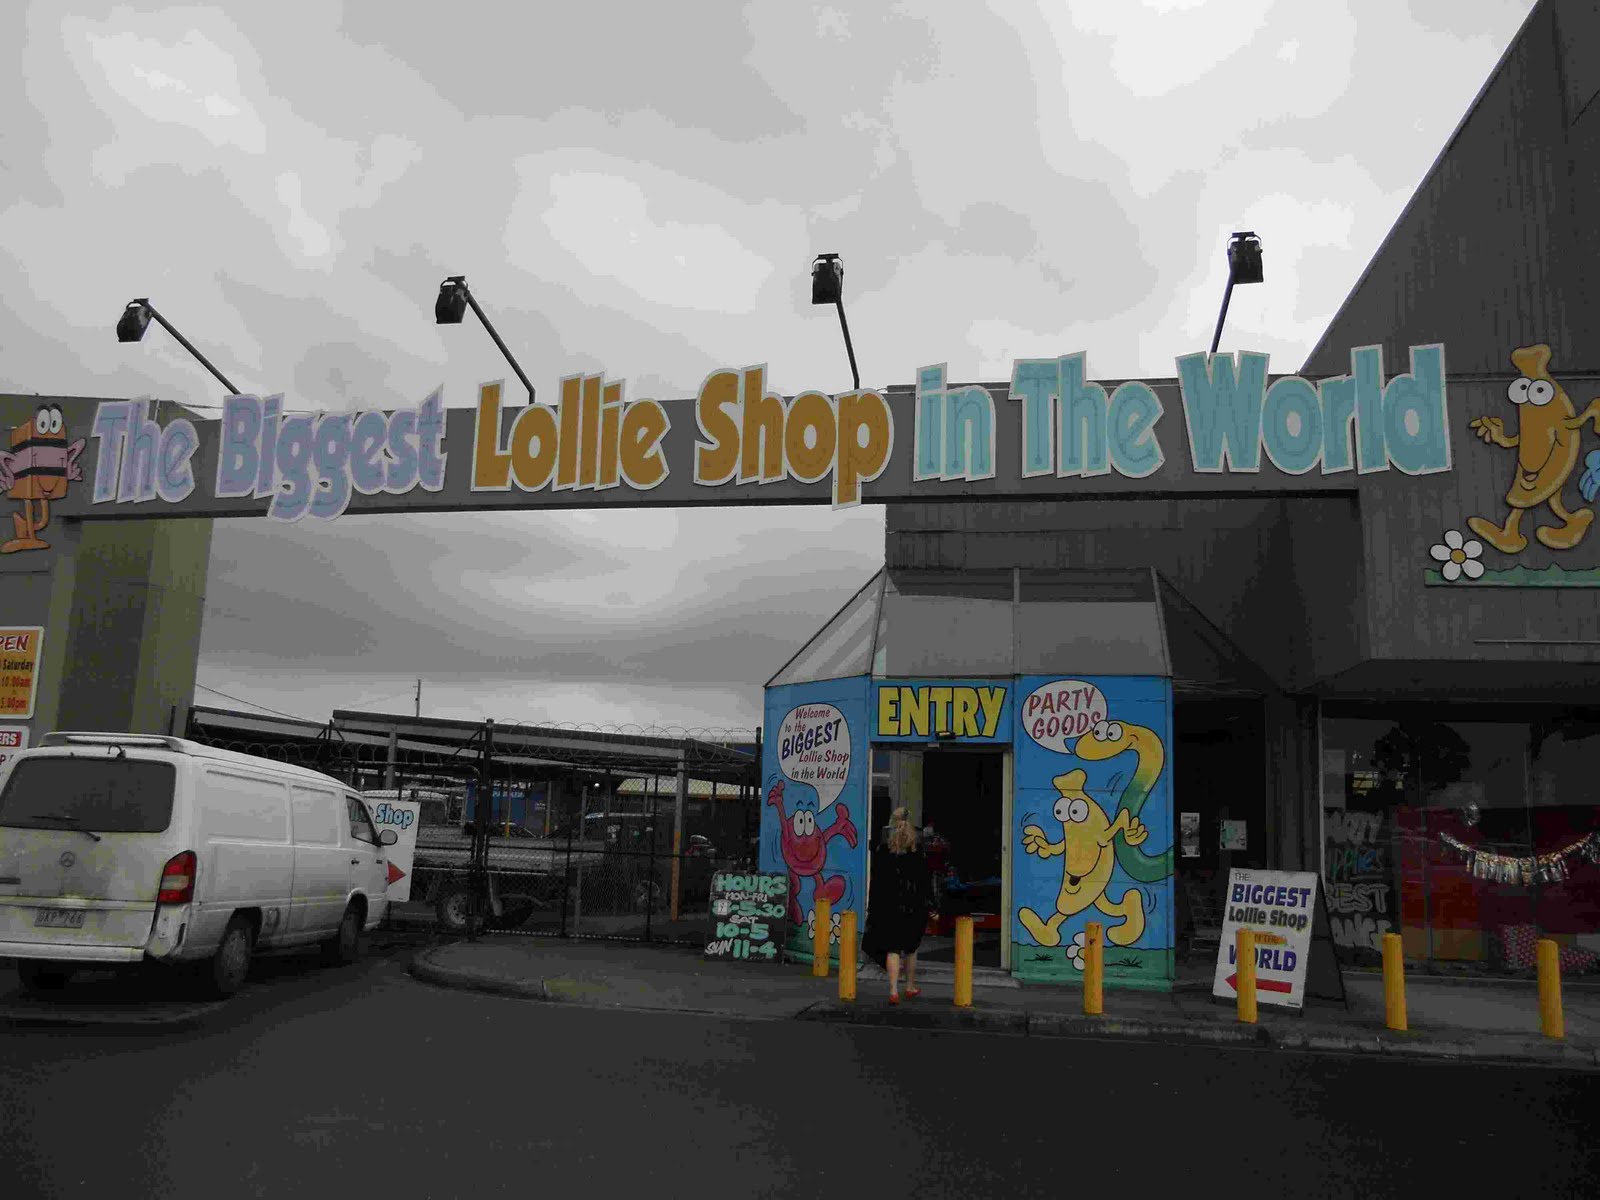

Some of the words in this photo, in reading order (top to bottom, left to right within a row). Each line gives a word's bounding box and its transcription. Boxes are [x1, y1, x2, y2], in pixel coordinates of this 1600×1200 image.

[93, 396, 200, 504] The
[215, 384, 449, 523] Biggest
[471, 372, 671, 492] Lollie
[693, 363, 894, 510] Shop
[914, 362, 996, 482] in
[1008, 350, 1165, 479] The
[1176, 343, 1453, 475] World
[2, 659, 34, 673] Saturday
[877, 686, 1006, 738] ENTRY
[1028, 686, 1096, 717] PARTY
[795, 707, 830, 719] Welcome
[784, 724, 791, 733] to
[794, 721, 806, 732] the
[782, 718, 841, 760] BIGGEST
[799, 750, 822, 763] Lollie
[823, 749, 849, 766] Shop
[791, 767, 799, 778] in
[800, 767, 815, 779] the
[816, 767, 847, 780] World
[376, 803, 415, 829] Shop
[715, 874, 787, 897] HOURS
[1235, 873, 1249, 881] THE
[1231, 883, 1311, 908] BIGGEST
[729, 914, 759, 925] SAT
[1228, 906, 1266, 923] Lollie
[1269, 909, 1308, 931] Shop
[716, 922, 769, 940] 10-5
[704, 939, 734, 955] SUN
[733, 939, 778, 959] 11-4
[1228, 944, 1297, 972] RLD
